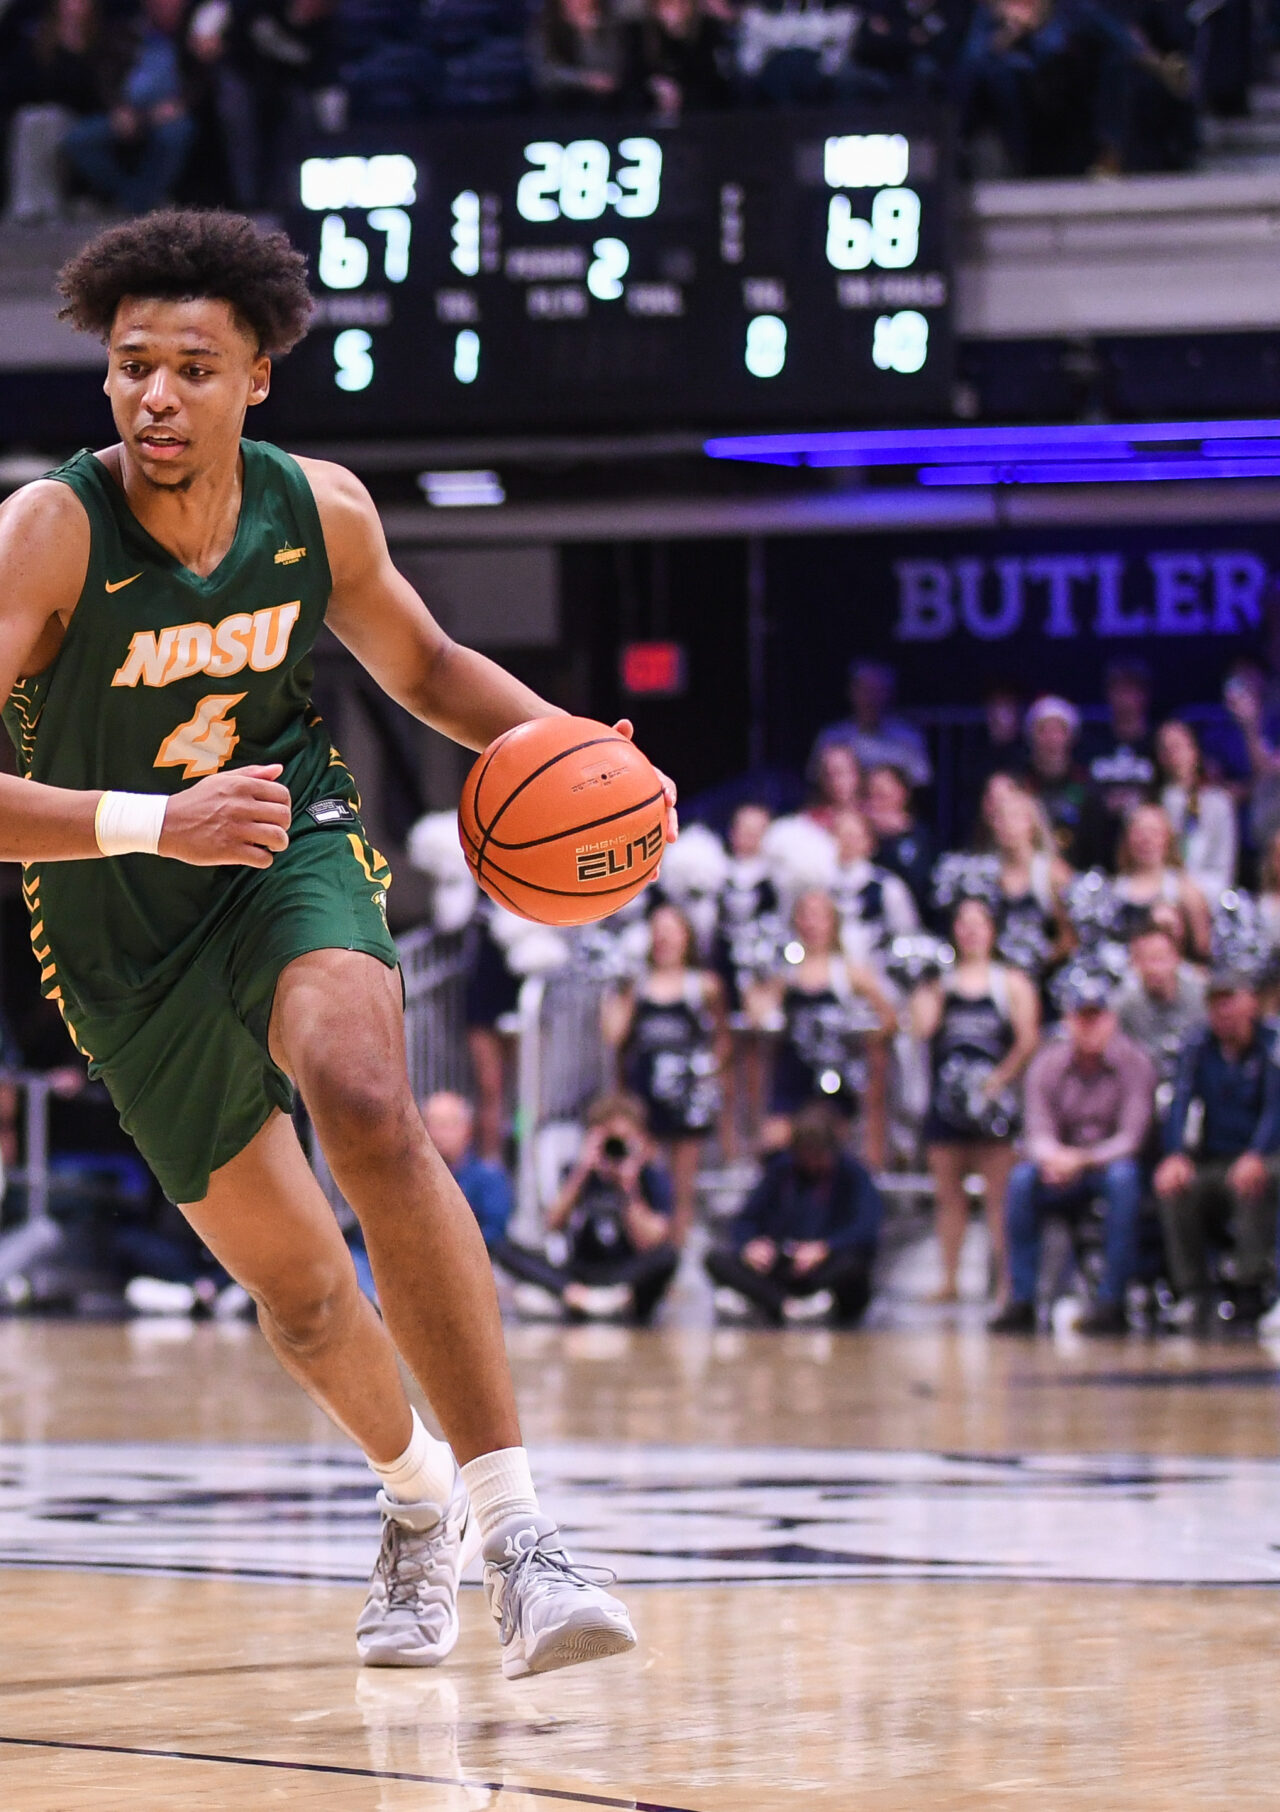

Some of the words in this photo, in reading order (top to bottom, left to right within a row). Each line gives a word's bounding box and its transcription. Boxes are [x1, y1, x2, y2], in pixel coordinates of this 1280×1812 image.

[517, 138, 663, 222] 28.3
[319, 208, 411, 289] 67
[587, 237, 630, 300] 2
[825, 187, 921, 270] 68
[334, 329, 374, 391] 5
[893, 551, 1268, 641] BUTLER
[111, 600, 301, 687] NDSU
[153, 691, 249, 780] 4
